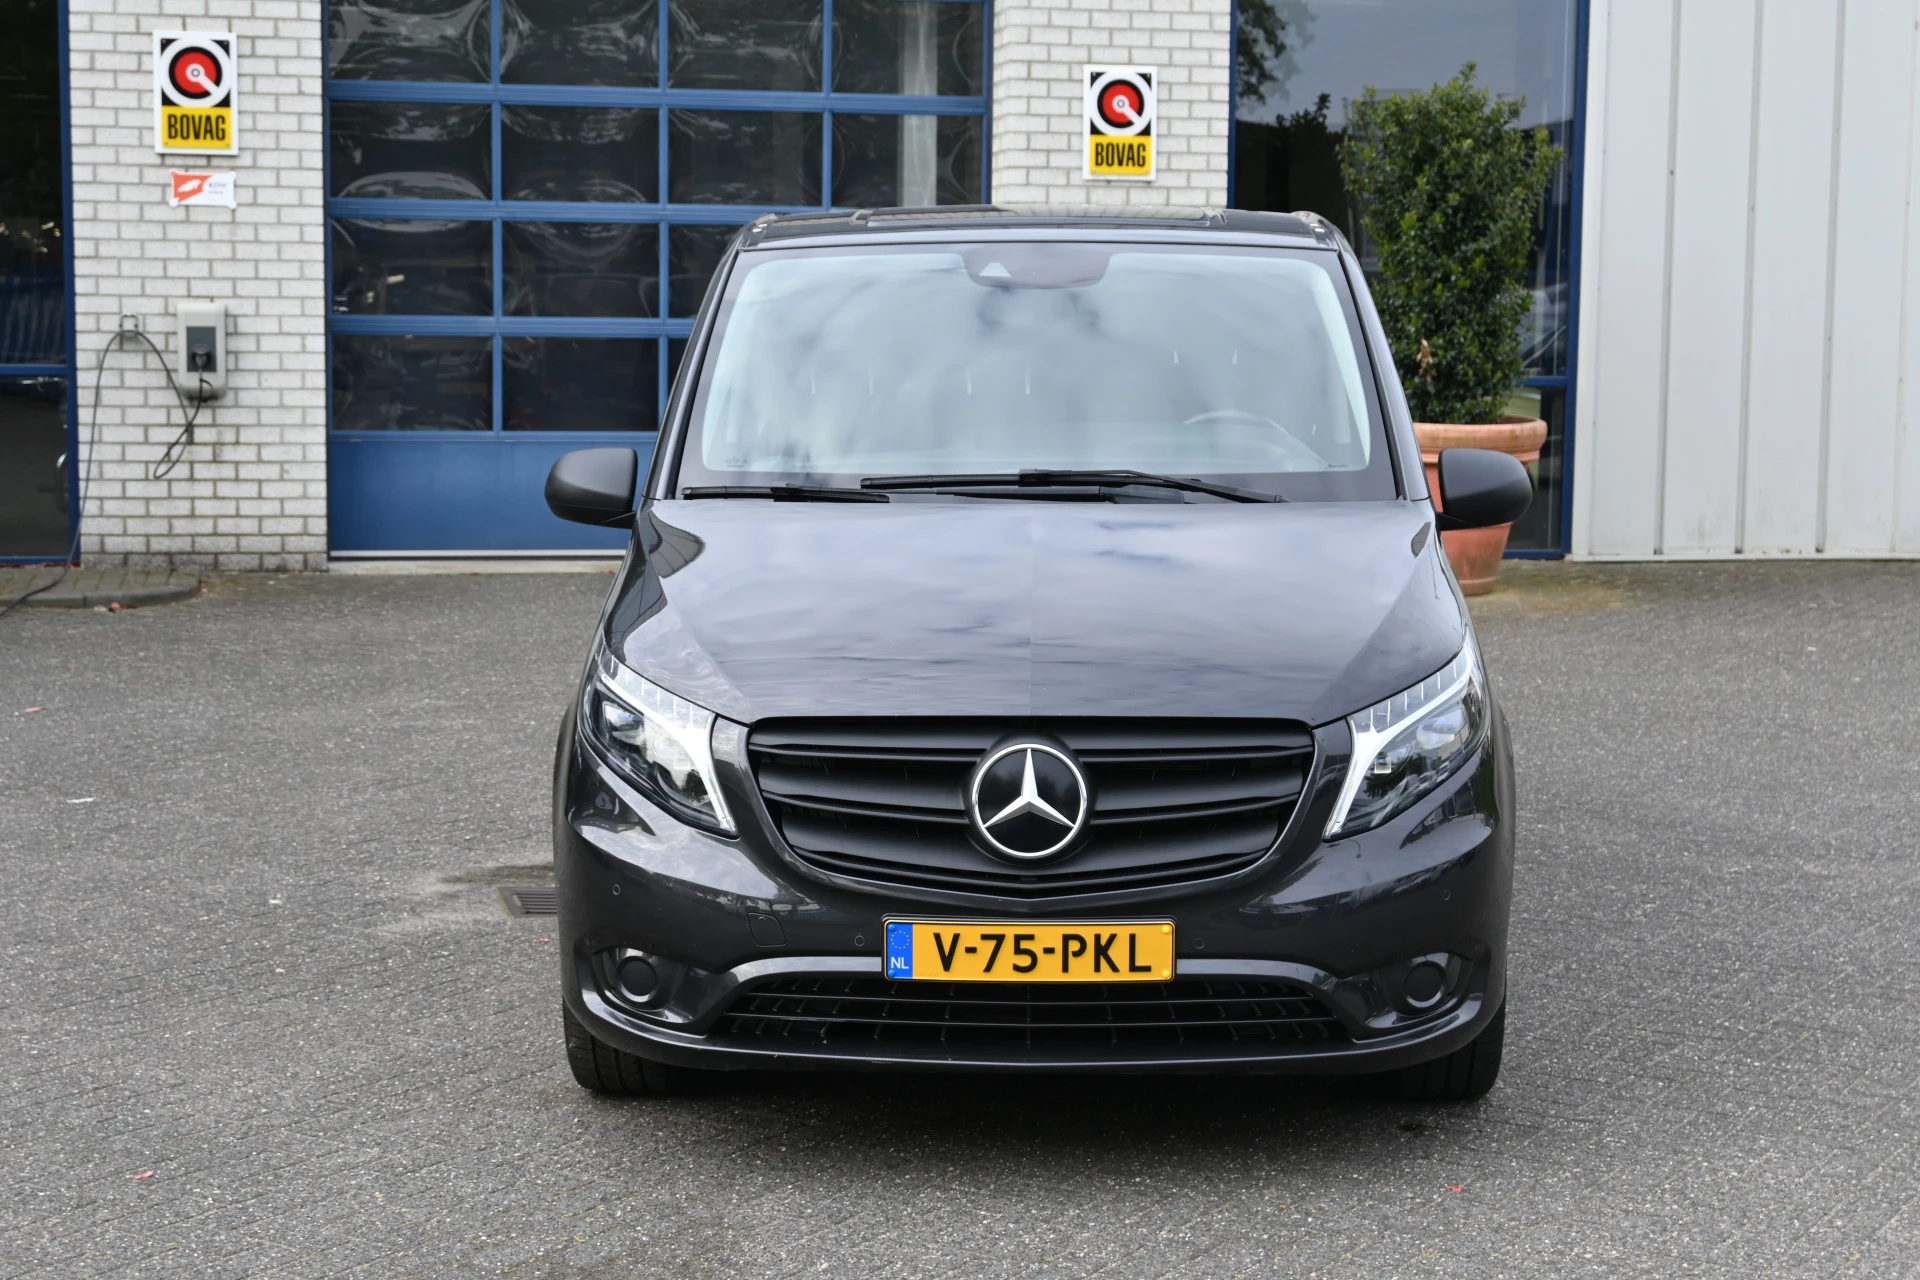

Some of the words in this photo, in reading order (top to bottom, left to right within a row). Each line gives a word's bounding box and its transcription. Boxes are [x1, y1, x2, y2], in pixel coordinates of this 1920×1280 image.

[167, 114, 226, 141] BOVAG
[1095, 142, 1146, 168] BOVAG
[890, 956, 909, 970] NL
[933, 932, 1152, 974] V-75-PKL
